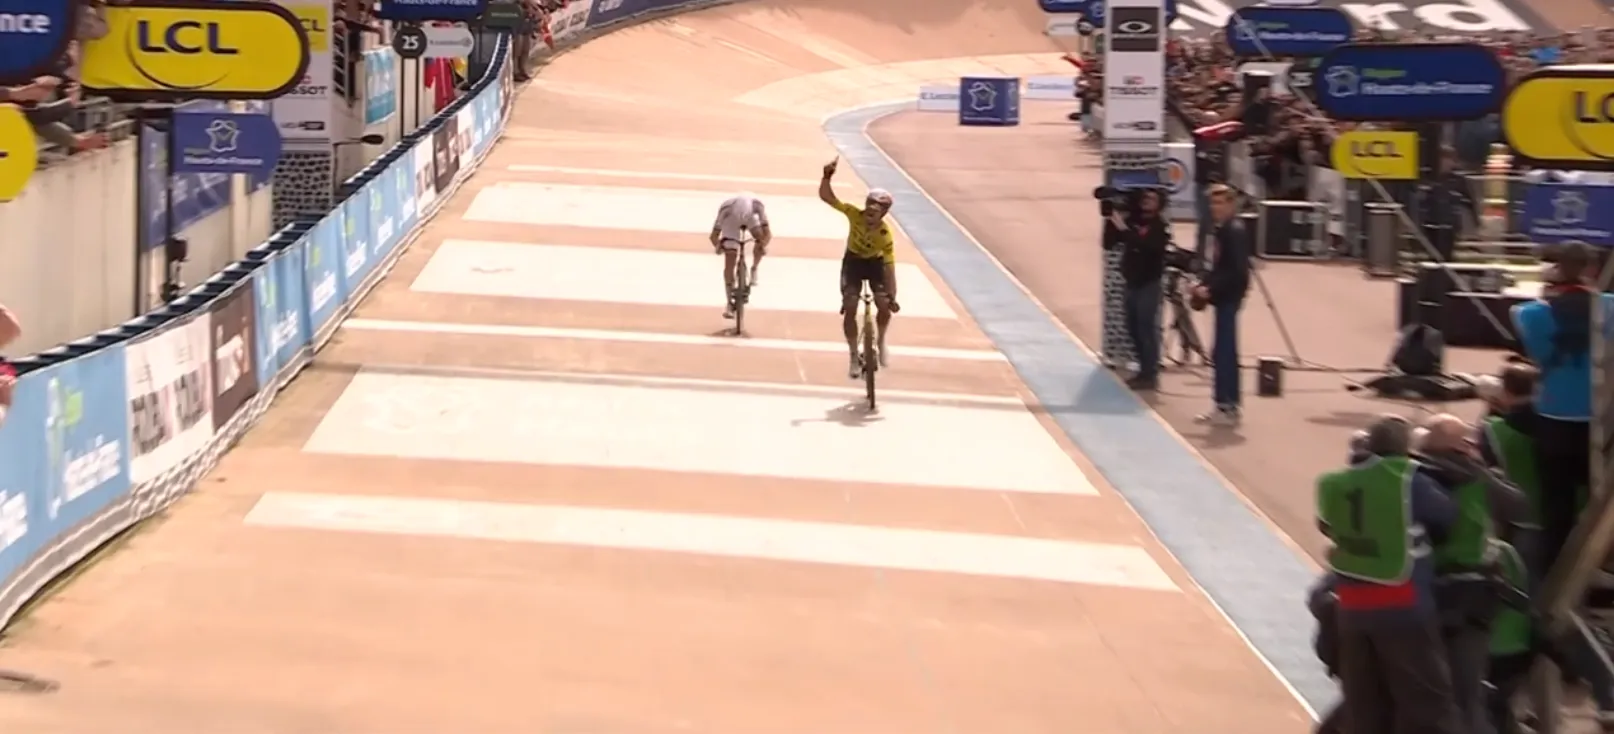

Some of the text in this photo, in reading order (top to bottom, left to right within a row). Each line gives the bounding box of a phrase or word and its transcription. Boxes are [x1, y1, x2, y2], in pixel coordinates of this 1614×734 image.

[299, 18, 325, 32] CL
[137, 20, 240, 54] LCL
[401, 35, 419, 50] 25
[290, 85, 328, 95] SSOT
[1350, 141, 1404, 158] LCL
[1345, 486, 1364, 535] 1
